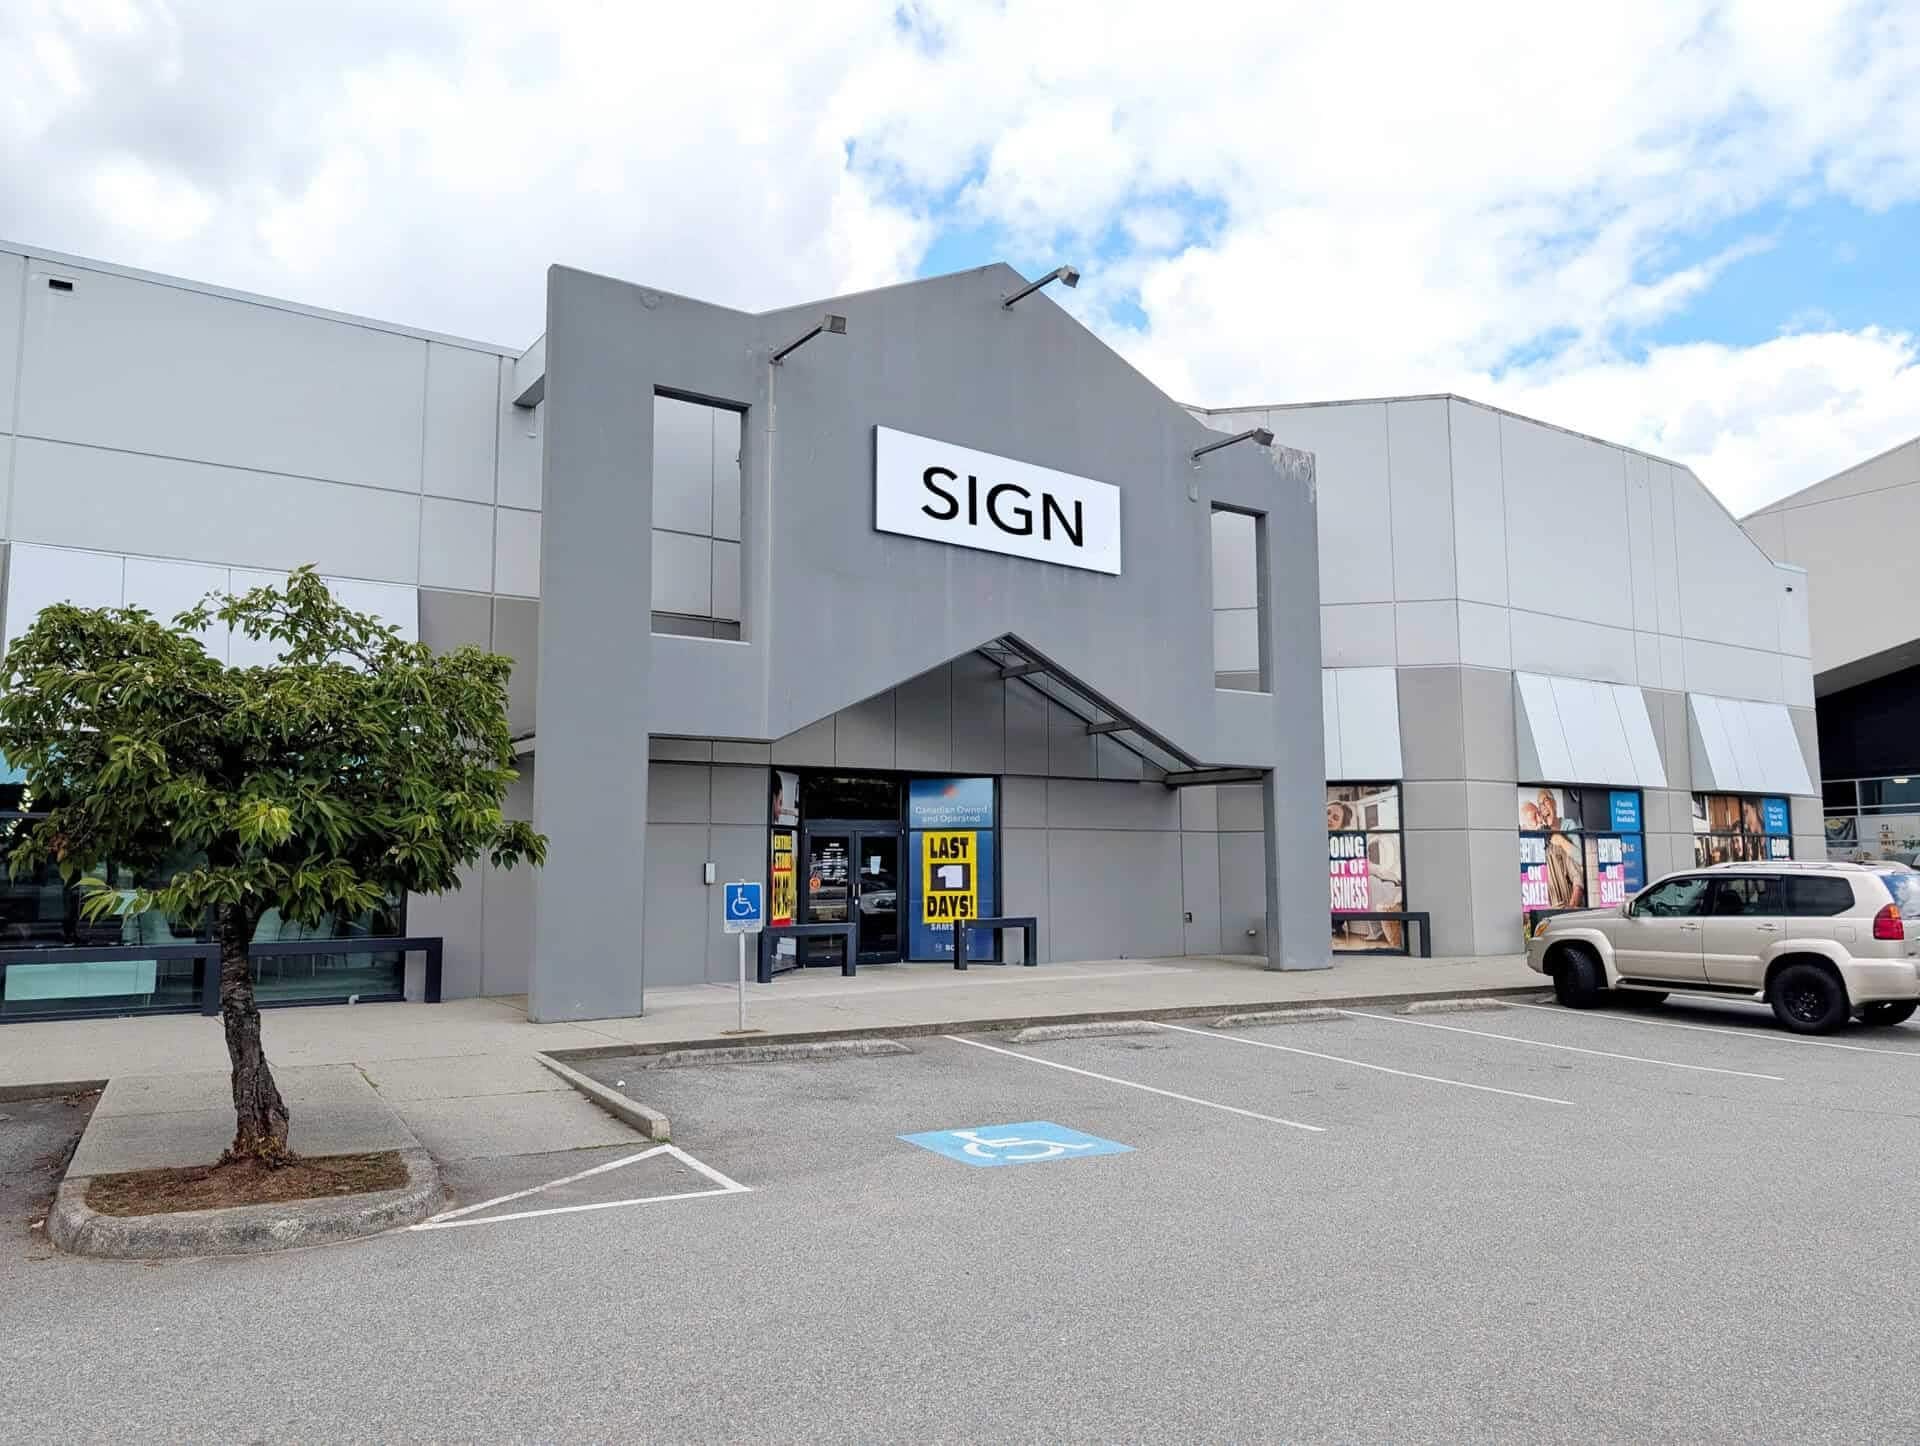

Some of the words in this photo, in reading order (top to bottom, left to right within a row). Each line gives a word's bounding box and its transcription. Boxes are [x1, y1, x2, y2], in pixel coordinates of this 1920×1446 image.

[921, 466, 1083, 547] SIGN
[914, 806, 955, 815] Canadian
[957, 805, 988, 814] Owned
[922, 815, 937, 823] and
[940, 815, 981, 825] Operated
[930, 837, 969, 859] LAST
[1330, 836, 1364, 858] OING
[1331, 859, 1347, 874] UT
[1350, 860, 1366, 874] OF
[1528, 866, 1541, 881] ON
[1606, 865, 1618, 880] ON
[1331, 876, 1369, 910] SINESS
[1521, 881, 1548, 905] SALE!
[1601, 880, 1625, 903] SALE!
[927, 895, 974, 918] DAYS!
